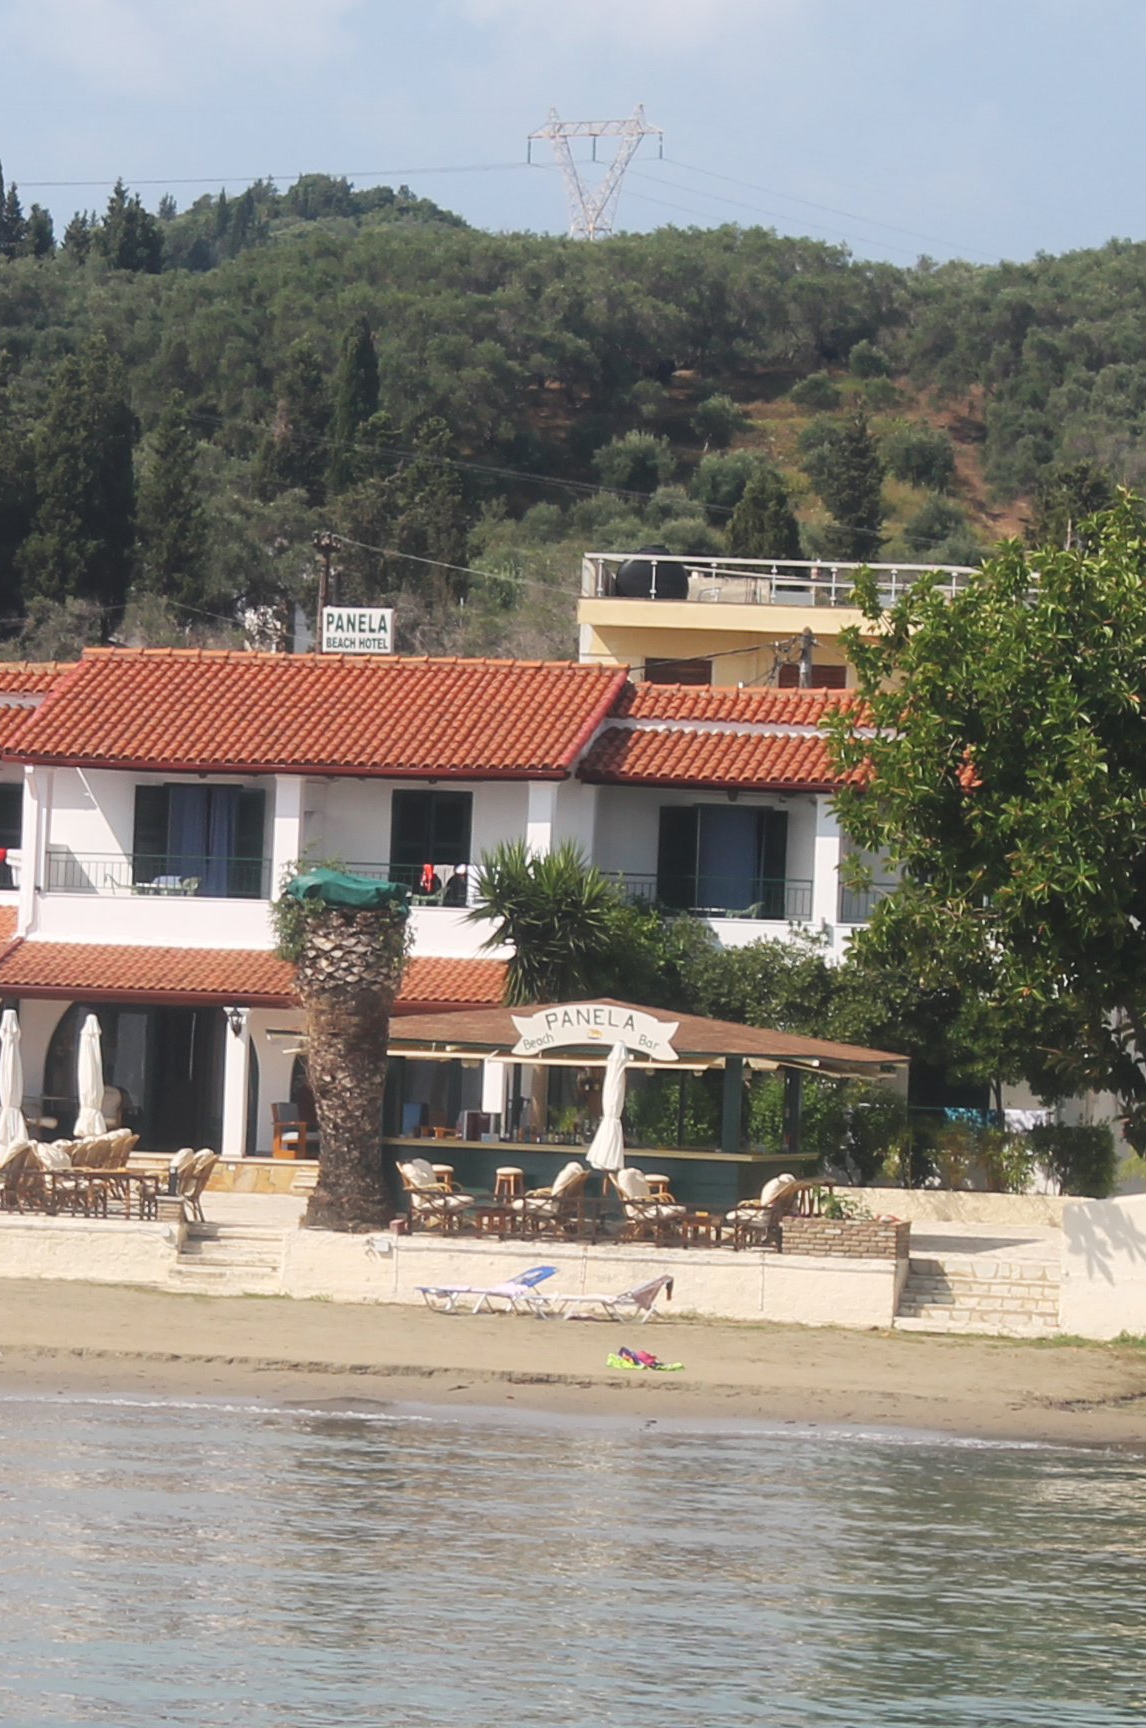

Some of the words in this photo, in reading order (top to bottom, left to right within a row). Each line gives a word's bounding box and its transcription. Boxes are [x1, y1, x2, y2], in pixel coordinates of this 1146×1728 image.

[327, 613, 388, 633] PANELA
[326, 637, 356, 649] BEACH
[359, 638, 388, 650] HOTEL
[545, 1008, 635, 1032] PANELA
[523, 1033, 555, 1050] Beach
[639, 1034, 660, 1050] Bar
